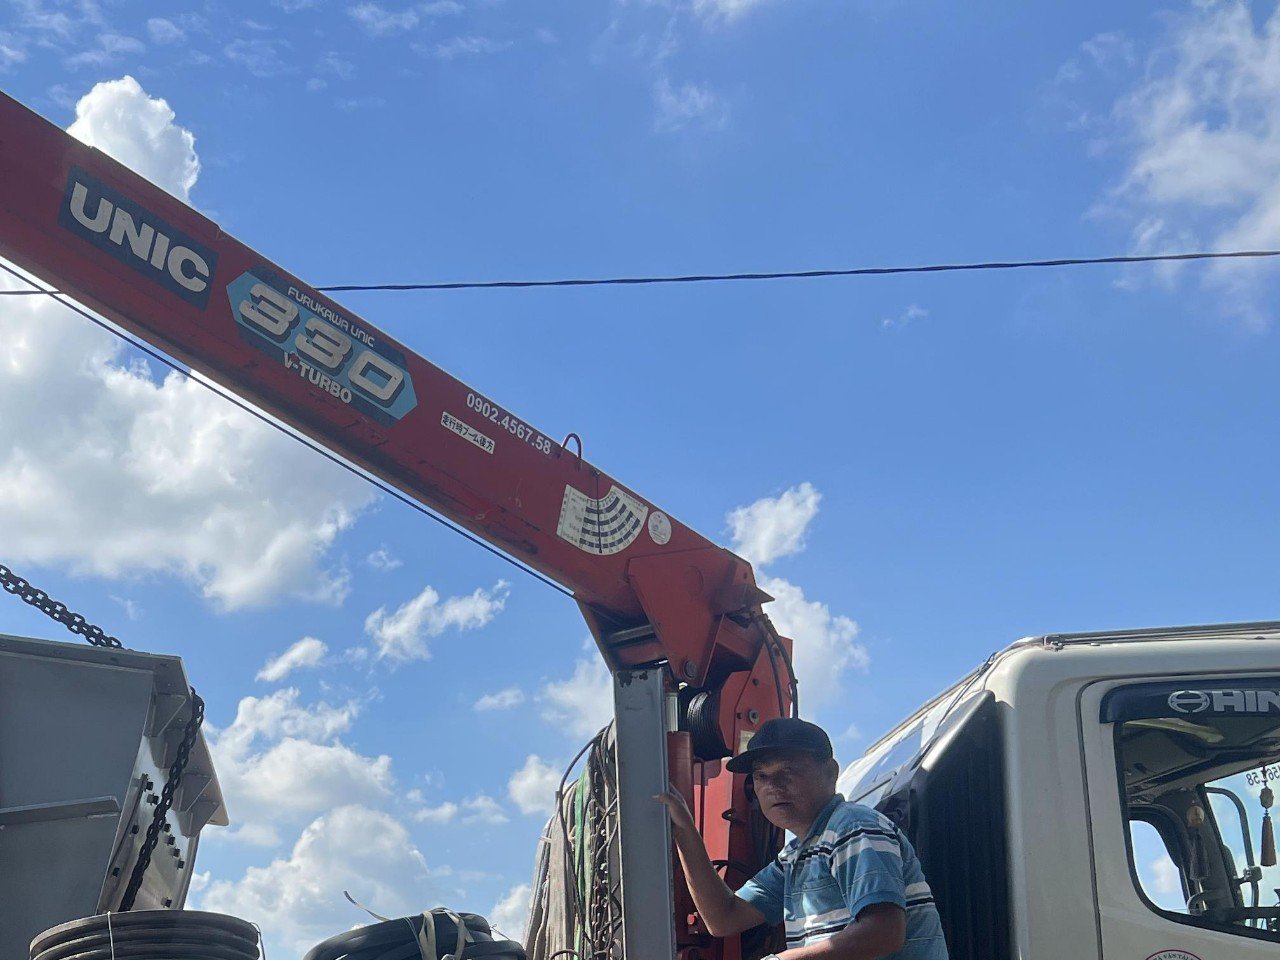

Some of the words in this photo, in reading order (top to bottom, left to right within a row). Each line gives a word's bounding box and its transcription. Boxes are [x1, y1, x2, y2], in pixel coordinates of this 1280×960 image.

[69, 181, 210, 293] UNIC
[238, 282, 404, 405] 330
[287, 286, 350, 332] FURUKAWA
[350, 322, 375, 348] UNIC
[283, 351, 353, 404] V-TURBO
[466, 393, 552, 455] 0902.4567.58
